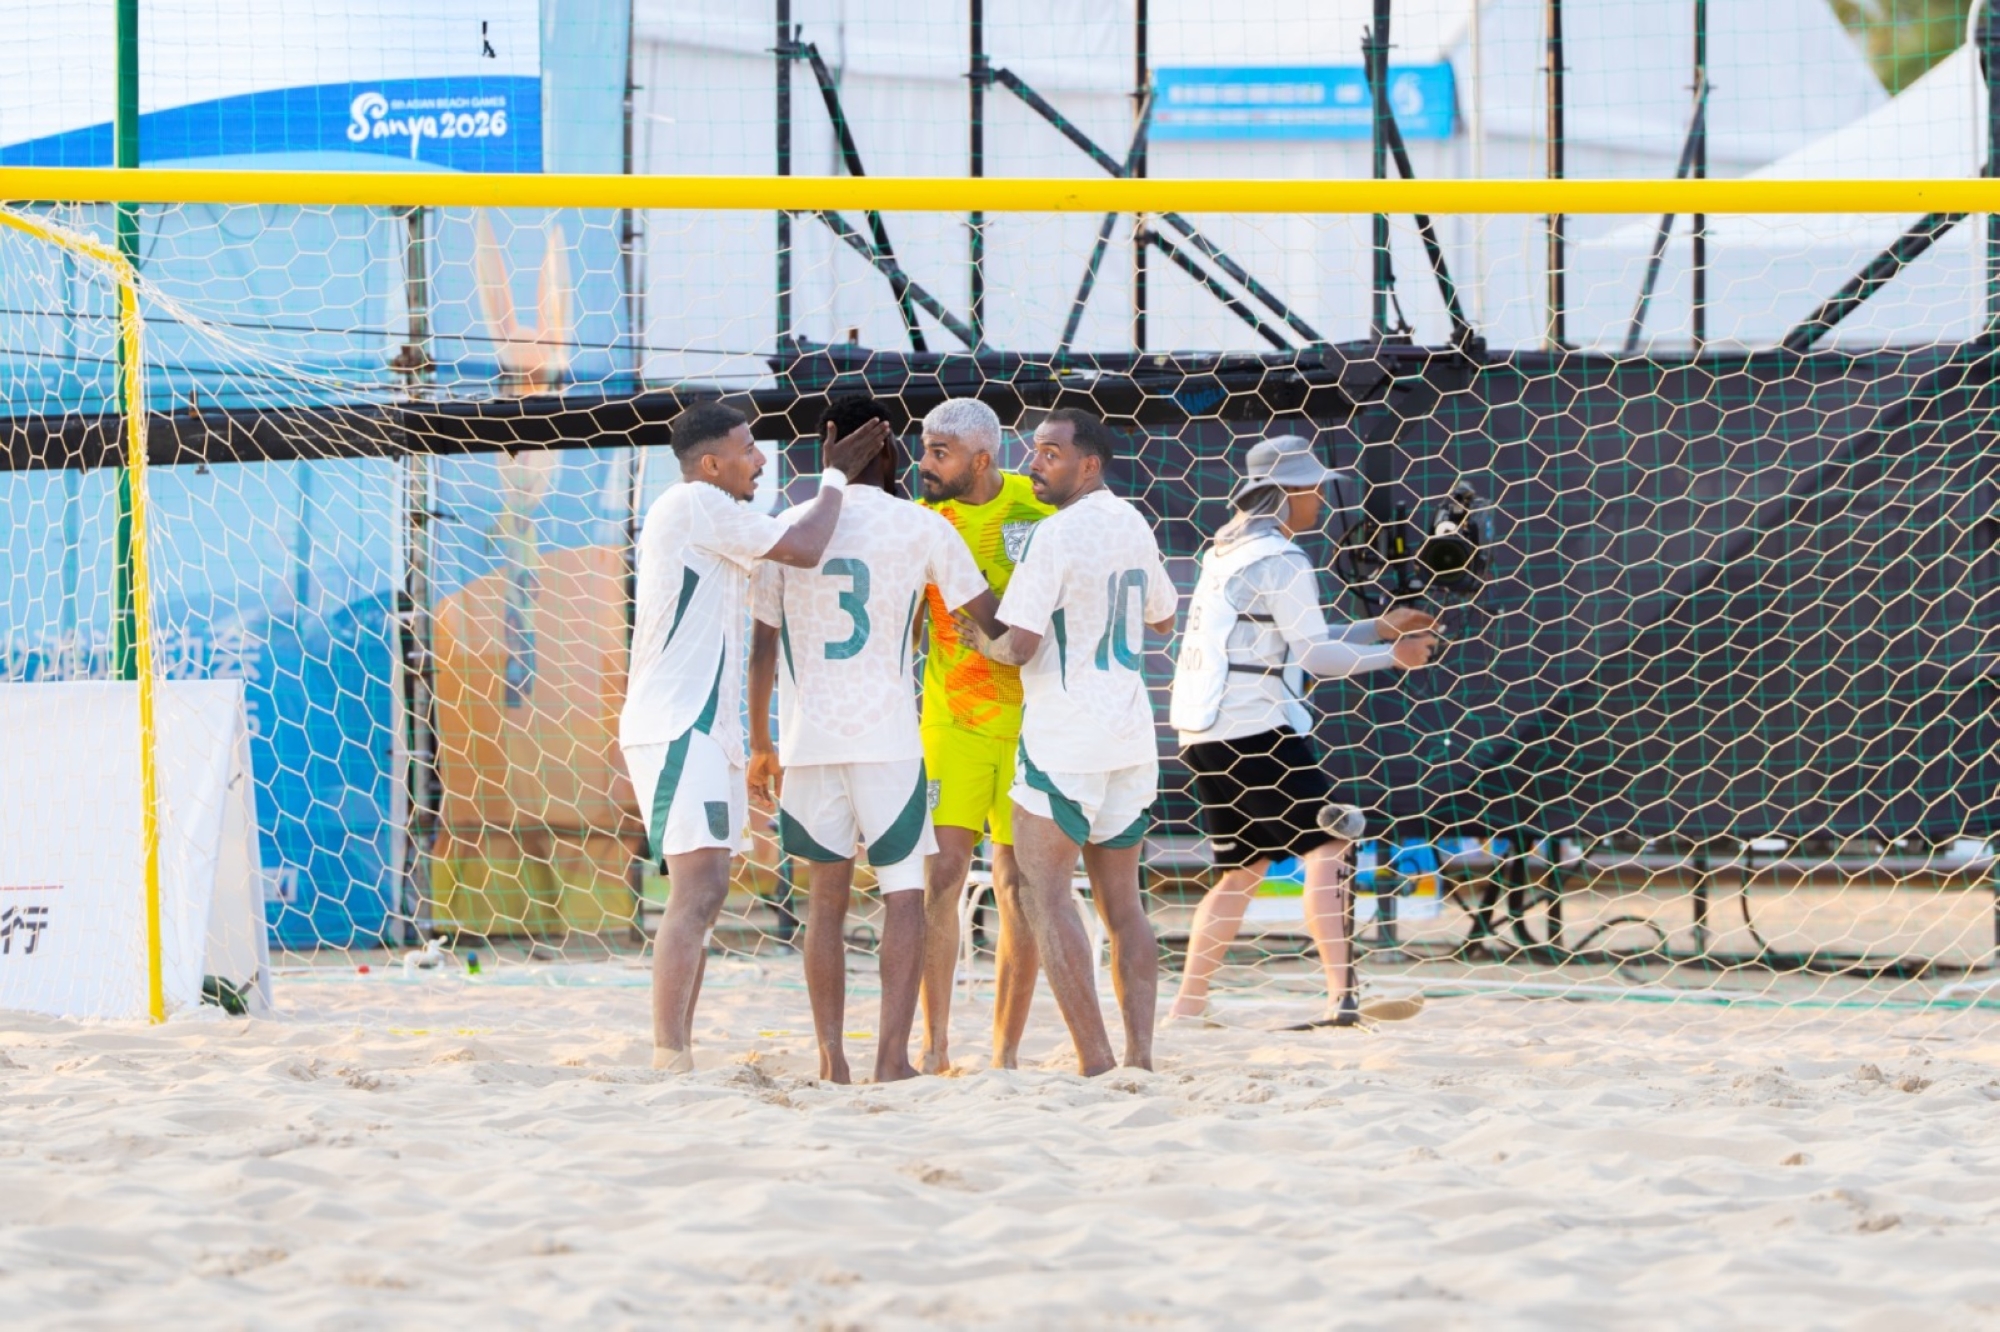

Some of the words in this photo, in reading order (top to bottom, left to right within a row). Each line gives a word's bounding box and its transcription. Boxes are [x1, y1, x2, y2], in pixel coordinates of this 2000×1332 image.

[347, 92, 438, 159] Sanya
[440, 110, 507, 139] 2026
[437, 98, 469, 109] BEACH
[471, 96, 506, 108] GAMES
[822, 557, 870, 660] 3
[1094, 568, 1149, 672] 10
